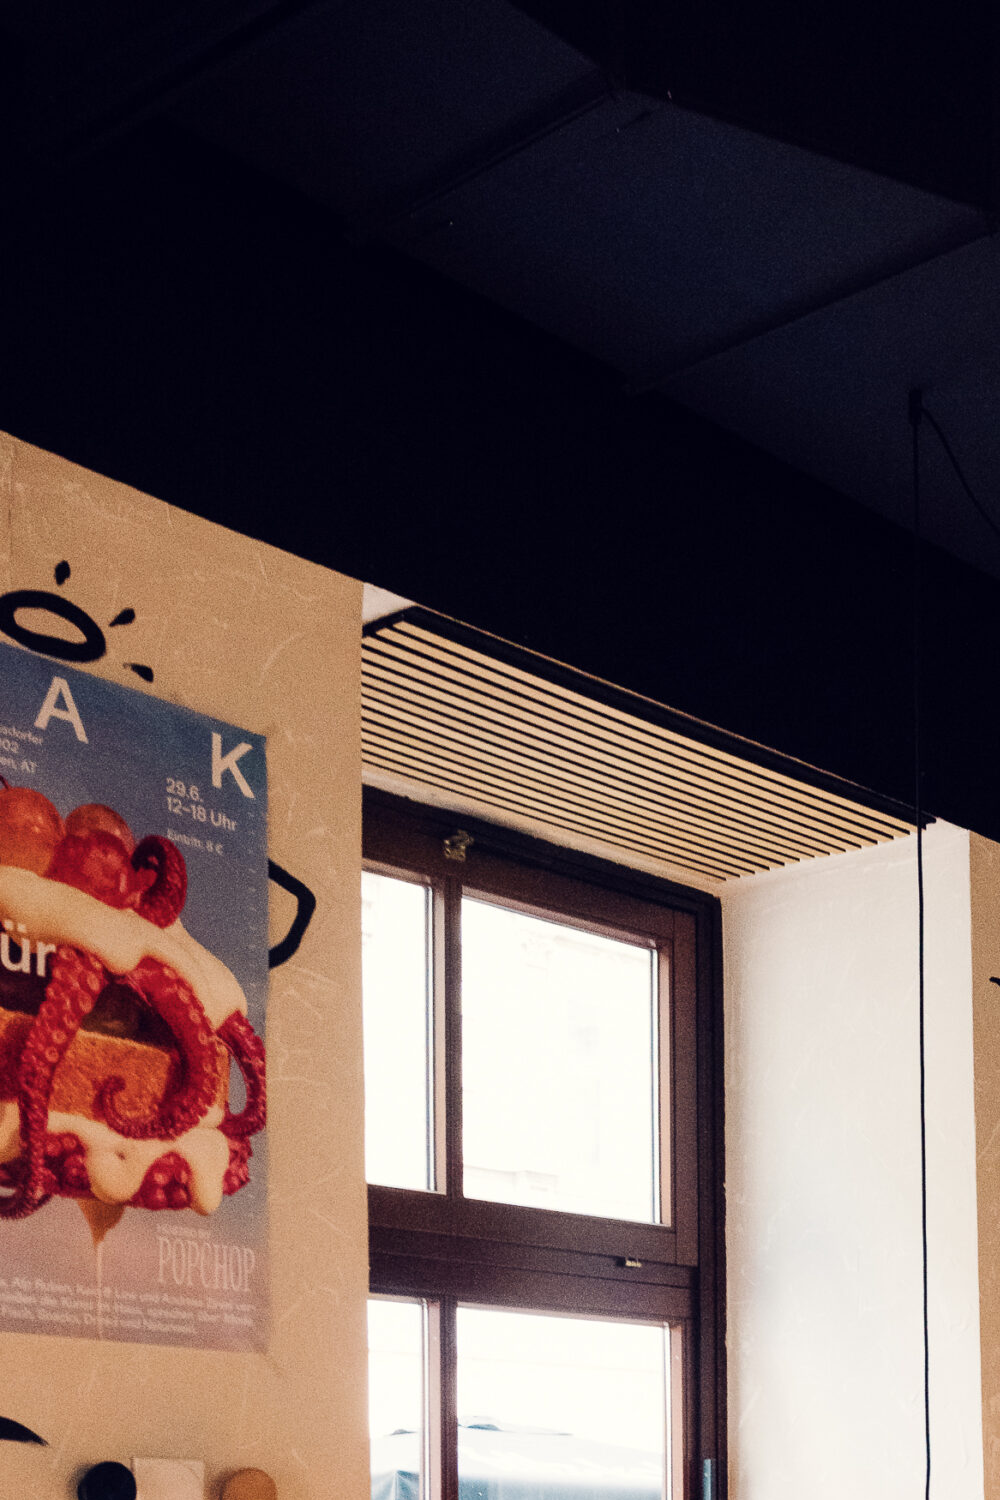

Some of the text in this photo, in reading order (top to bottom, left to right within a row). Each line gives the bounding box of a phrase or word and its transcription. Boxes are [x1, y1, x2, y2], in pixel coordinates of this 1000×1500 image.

[35, 676, 255, 799] A K
[167, 796, 237, 832] 12-18 Uhr
[159, 1235, 255, 1292] POPCHOP
